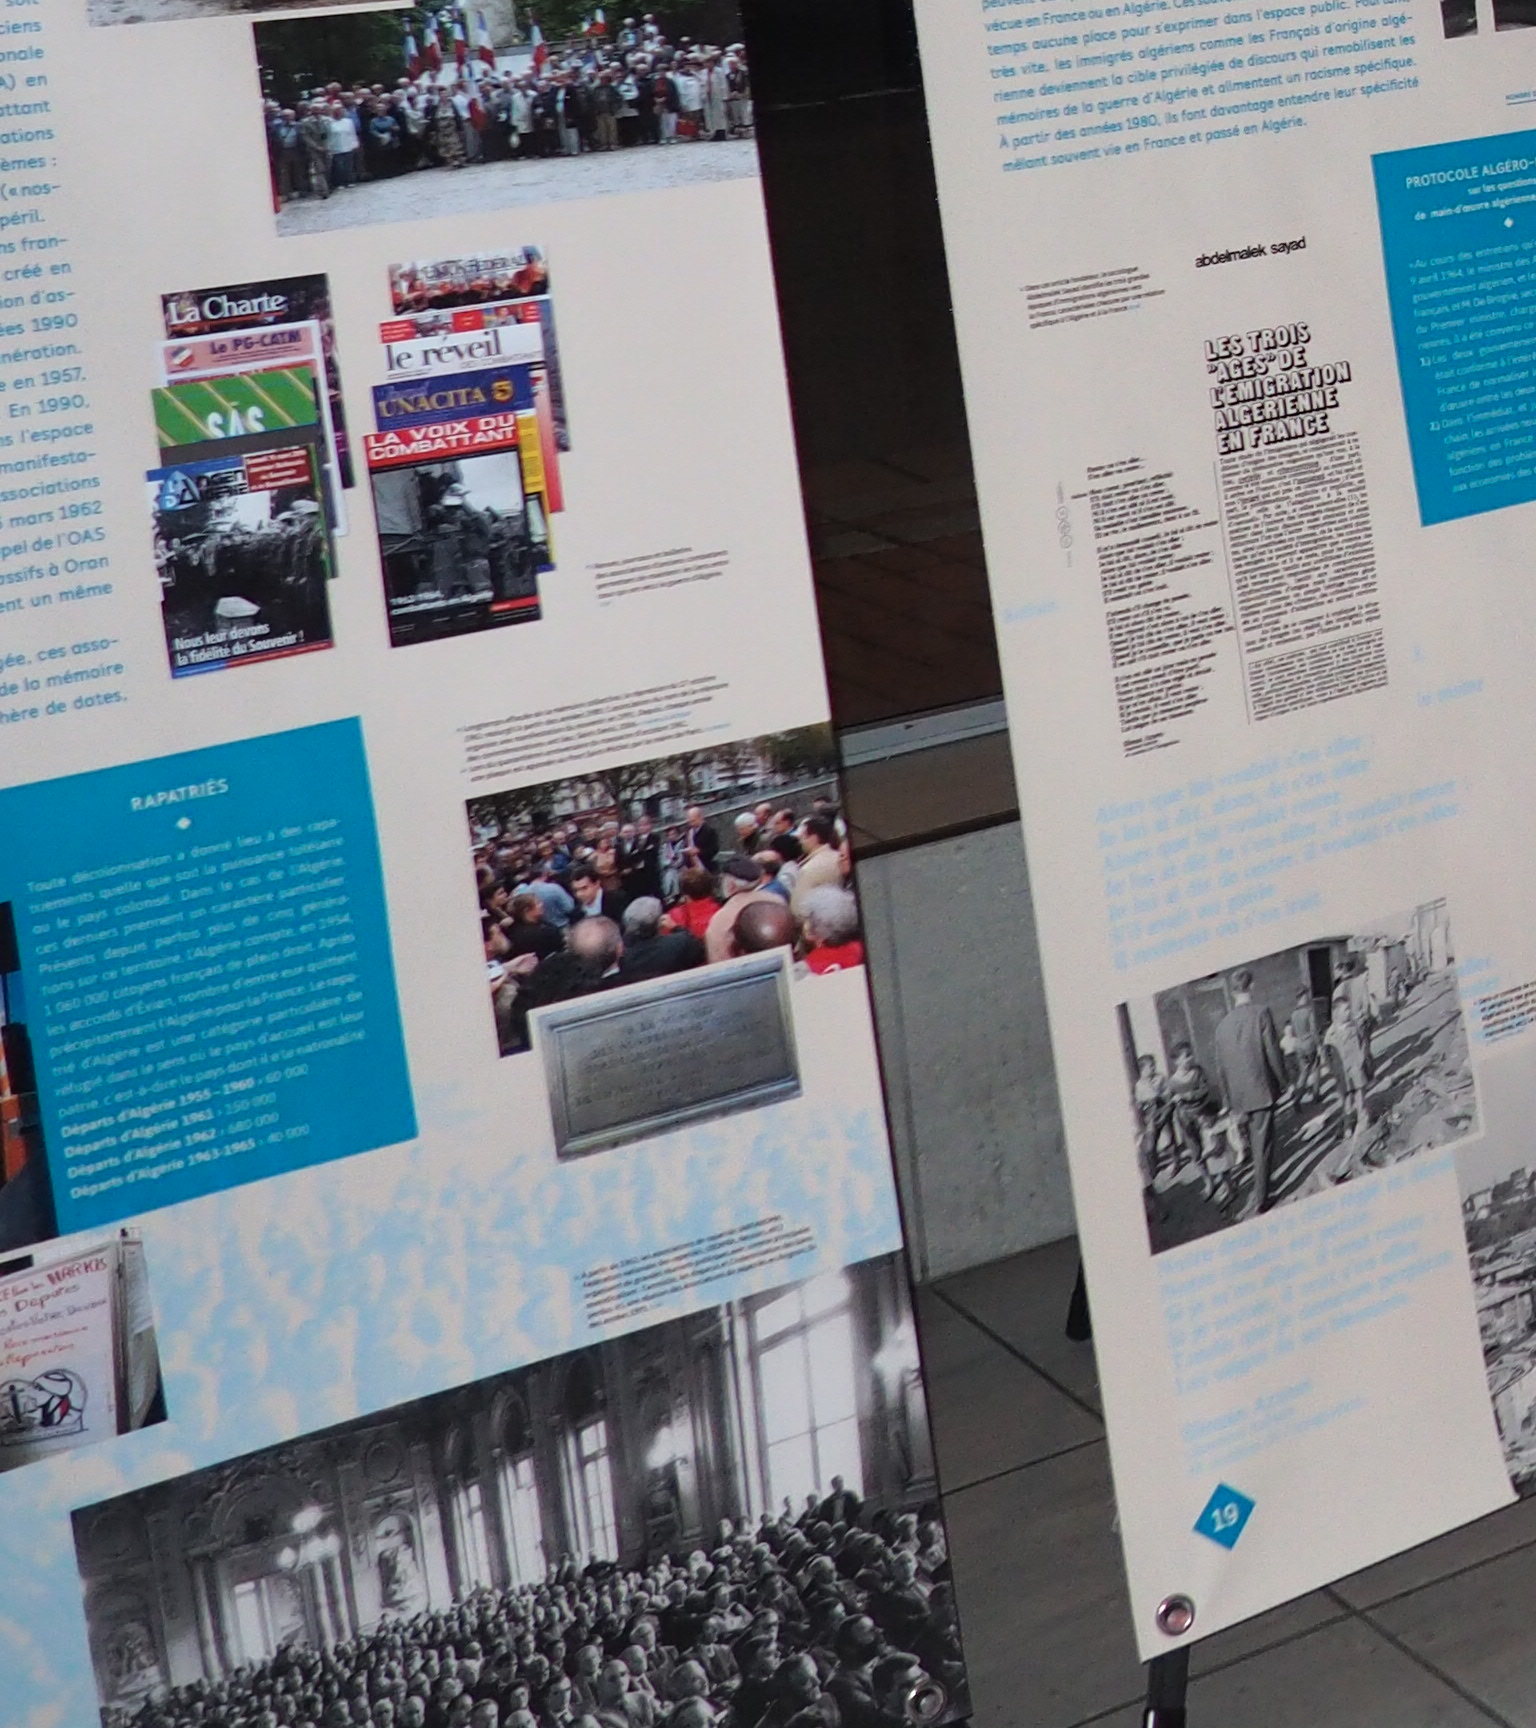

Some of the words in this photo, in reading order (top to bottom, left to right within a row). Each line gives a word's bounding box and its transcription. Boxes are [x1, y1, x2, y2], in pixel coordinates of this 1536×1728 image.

[1406, 166, 1479, 189] PROTOCOLE
[1414, 211, 1427, 221] de
[1195, 243, 1267, 268] abdelmalek
[1270, 236, 1306, 257] sayad
[167, 302, 201, 325] La
[204, 293, 288, 320] Charte
[210, 341, 227, 355] Le
[385, 344, 411, 372] le
[422, 329, 503, 367] réveil
[1205, 334, 1244, 362] LES
[1247, 322, 1311, 353] TROIS
[1278, 346, 1307, 372] DE
[13, 374, 35, 390] en
[1209, 360, 1352, 409] L'EMIGRATION
[379, 387, 486, 418] UNACITA
[1215, 387, 1339, 432] ALGERIENNE
[369, 431, 400, 448] LA
[411, 421, 469, 441] VOIX
[480, 413, 515, 430] DU
[369, 427, 517, 460] COMBATTANT
[1217, 430, 1244, 455] EN
[1250, 412, 1330, 448] FRANCE
[10, 507, 54, 528] mars
[59, 499, 104, 521] 1962
[46, 660, 124, 689] mémoire
[130, 778, 229, 812] RAPATRIÉS
[1210, 1501, 1240, 1533] 19
